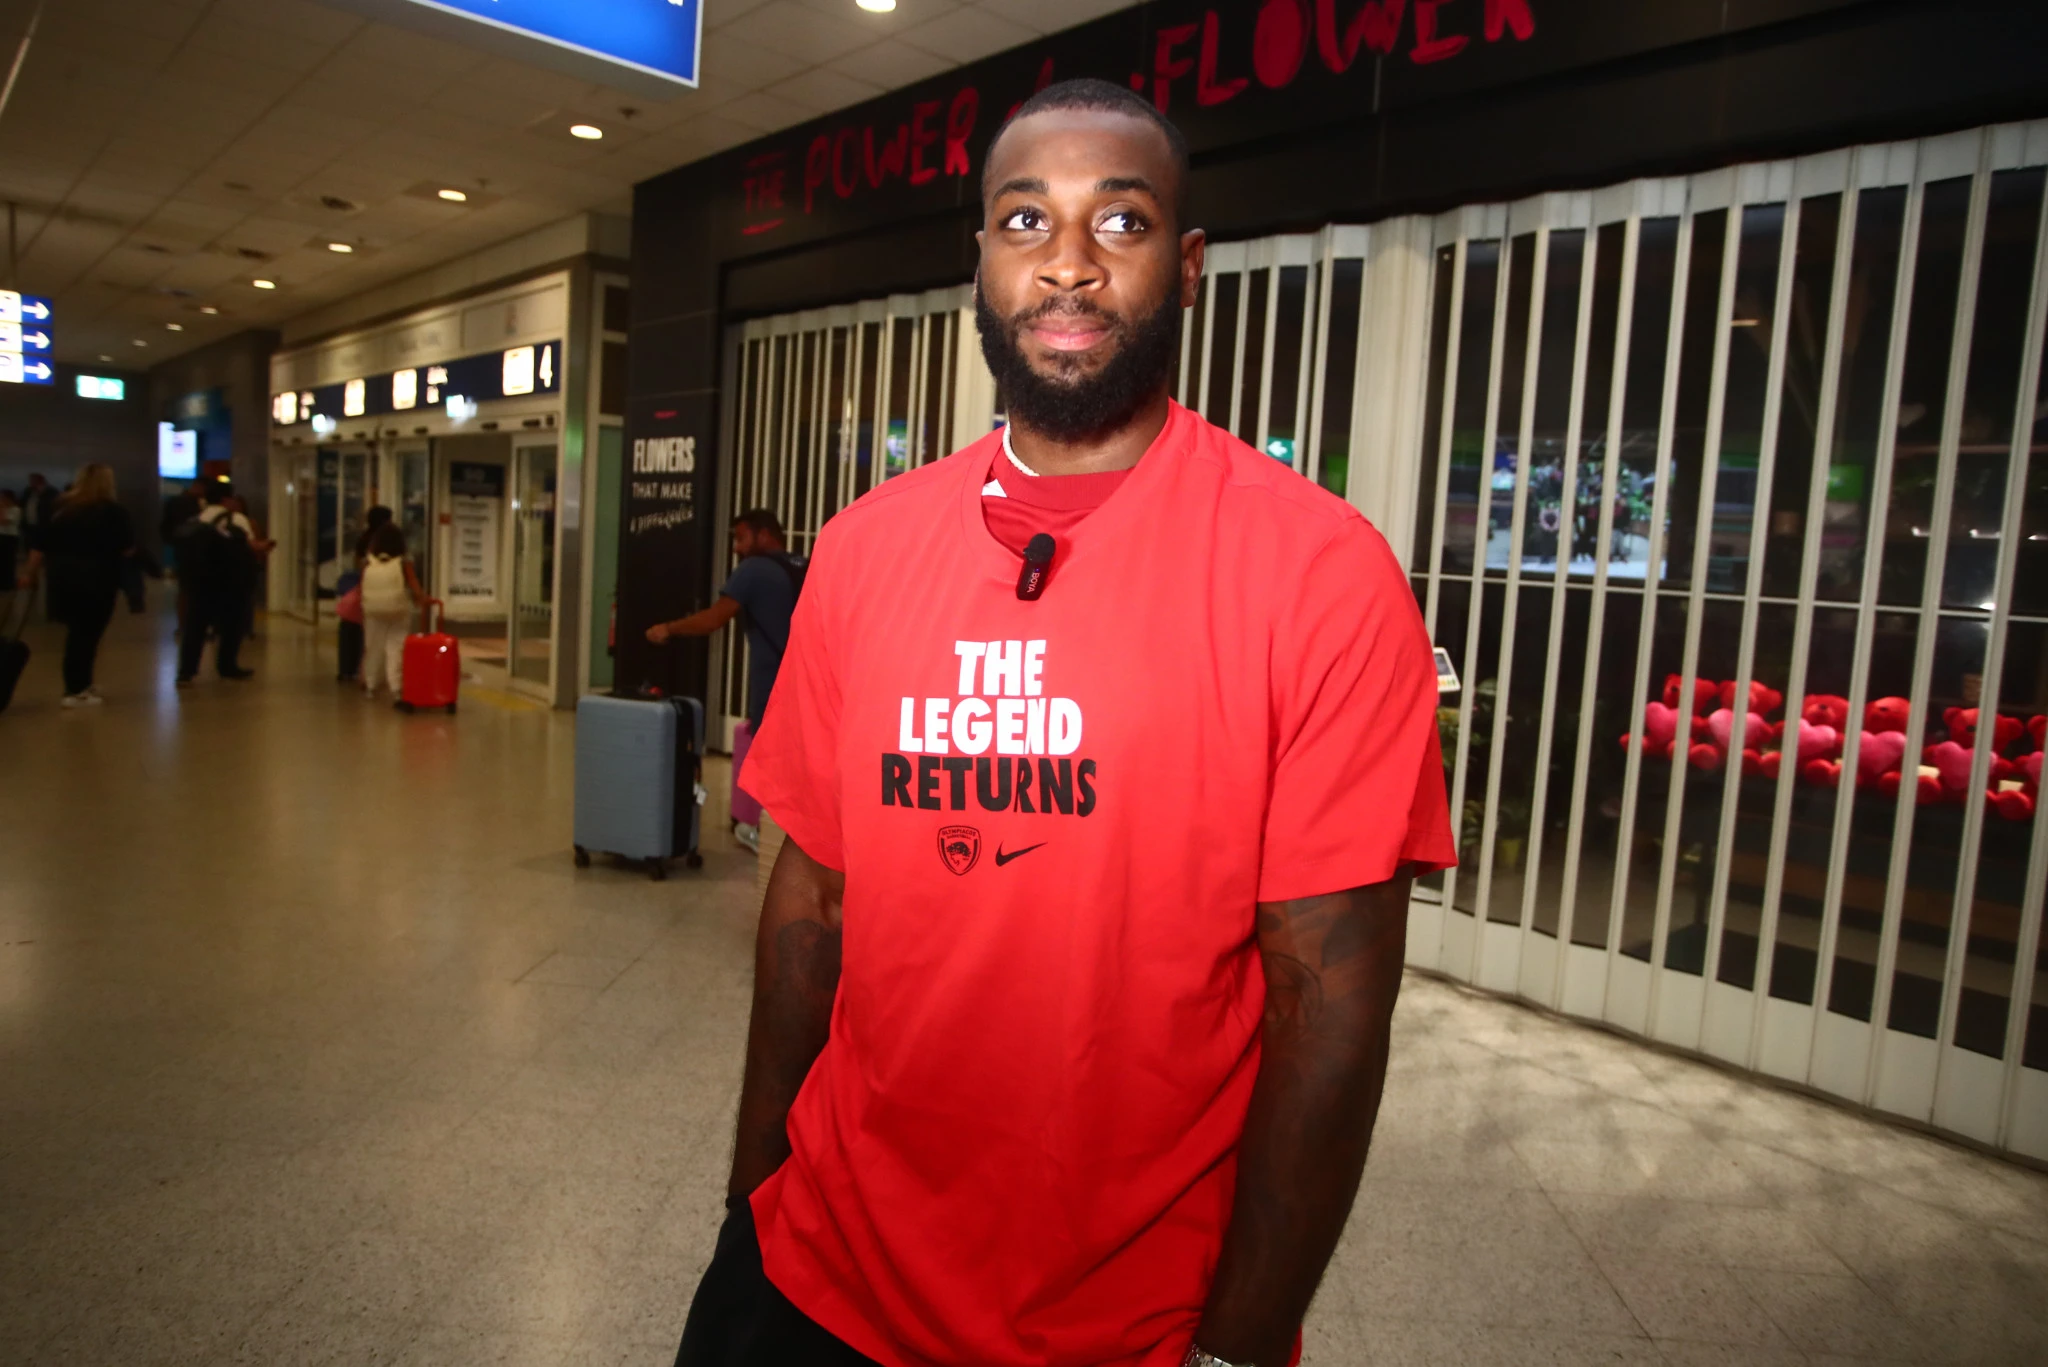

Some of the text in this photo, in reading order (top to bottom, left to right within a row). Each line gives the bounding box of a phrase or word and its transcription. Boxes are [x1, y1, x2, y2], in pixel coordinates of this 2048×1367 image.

[743, 170, 786, 213] THE
[804, 86, 979, 214] POWER
[540, 345, 554, 388] 4
[632, 436, 695, 473] FLOWERS
[632, 481, 692, 499] THAT MAKE
[954, 639, 1047, 696] THE
[899, 696, 1083, 755] LEGEND
[881, 753, 1097, 818] RETURNS
